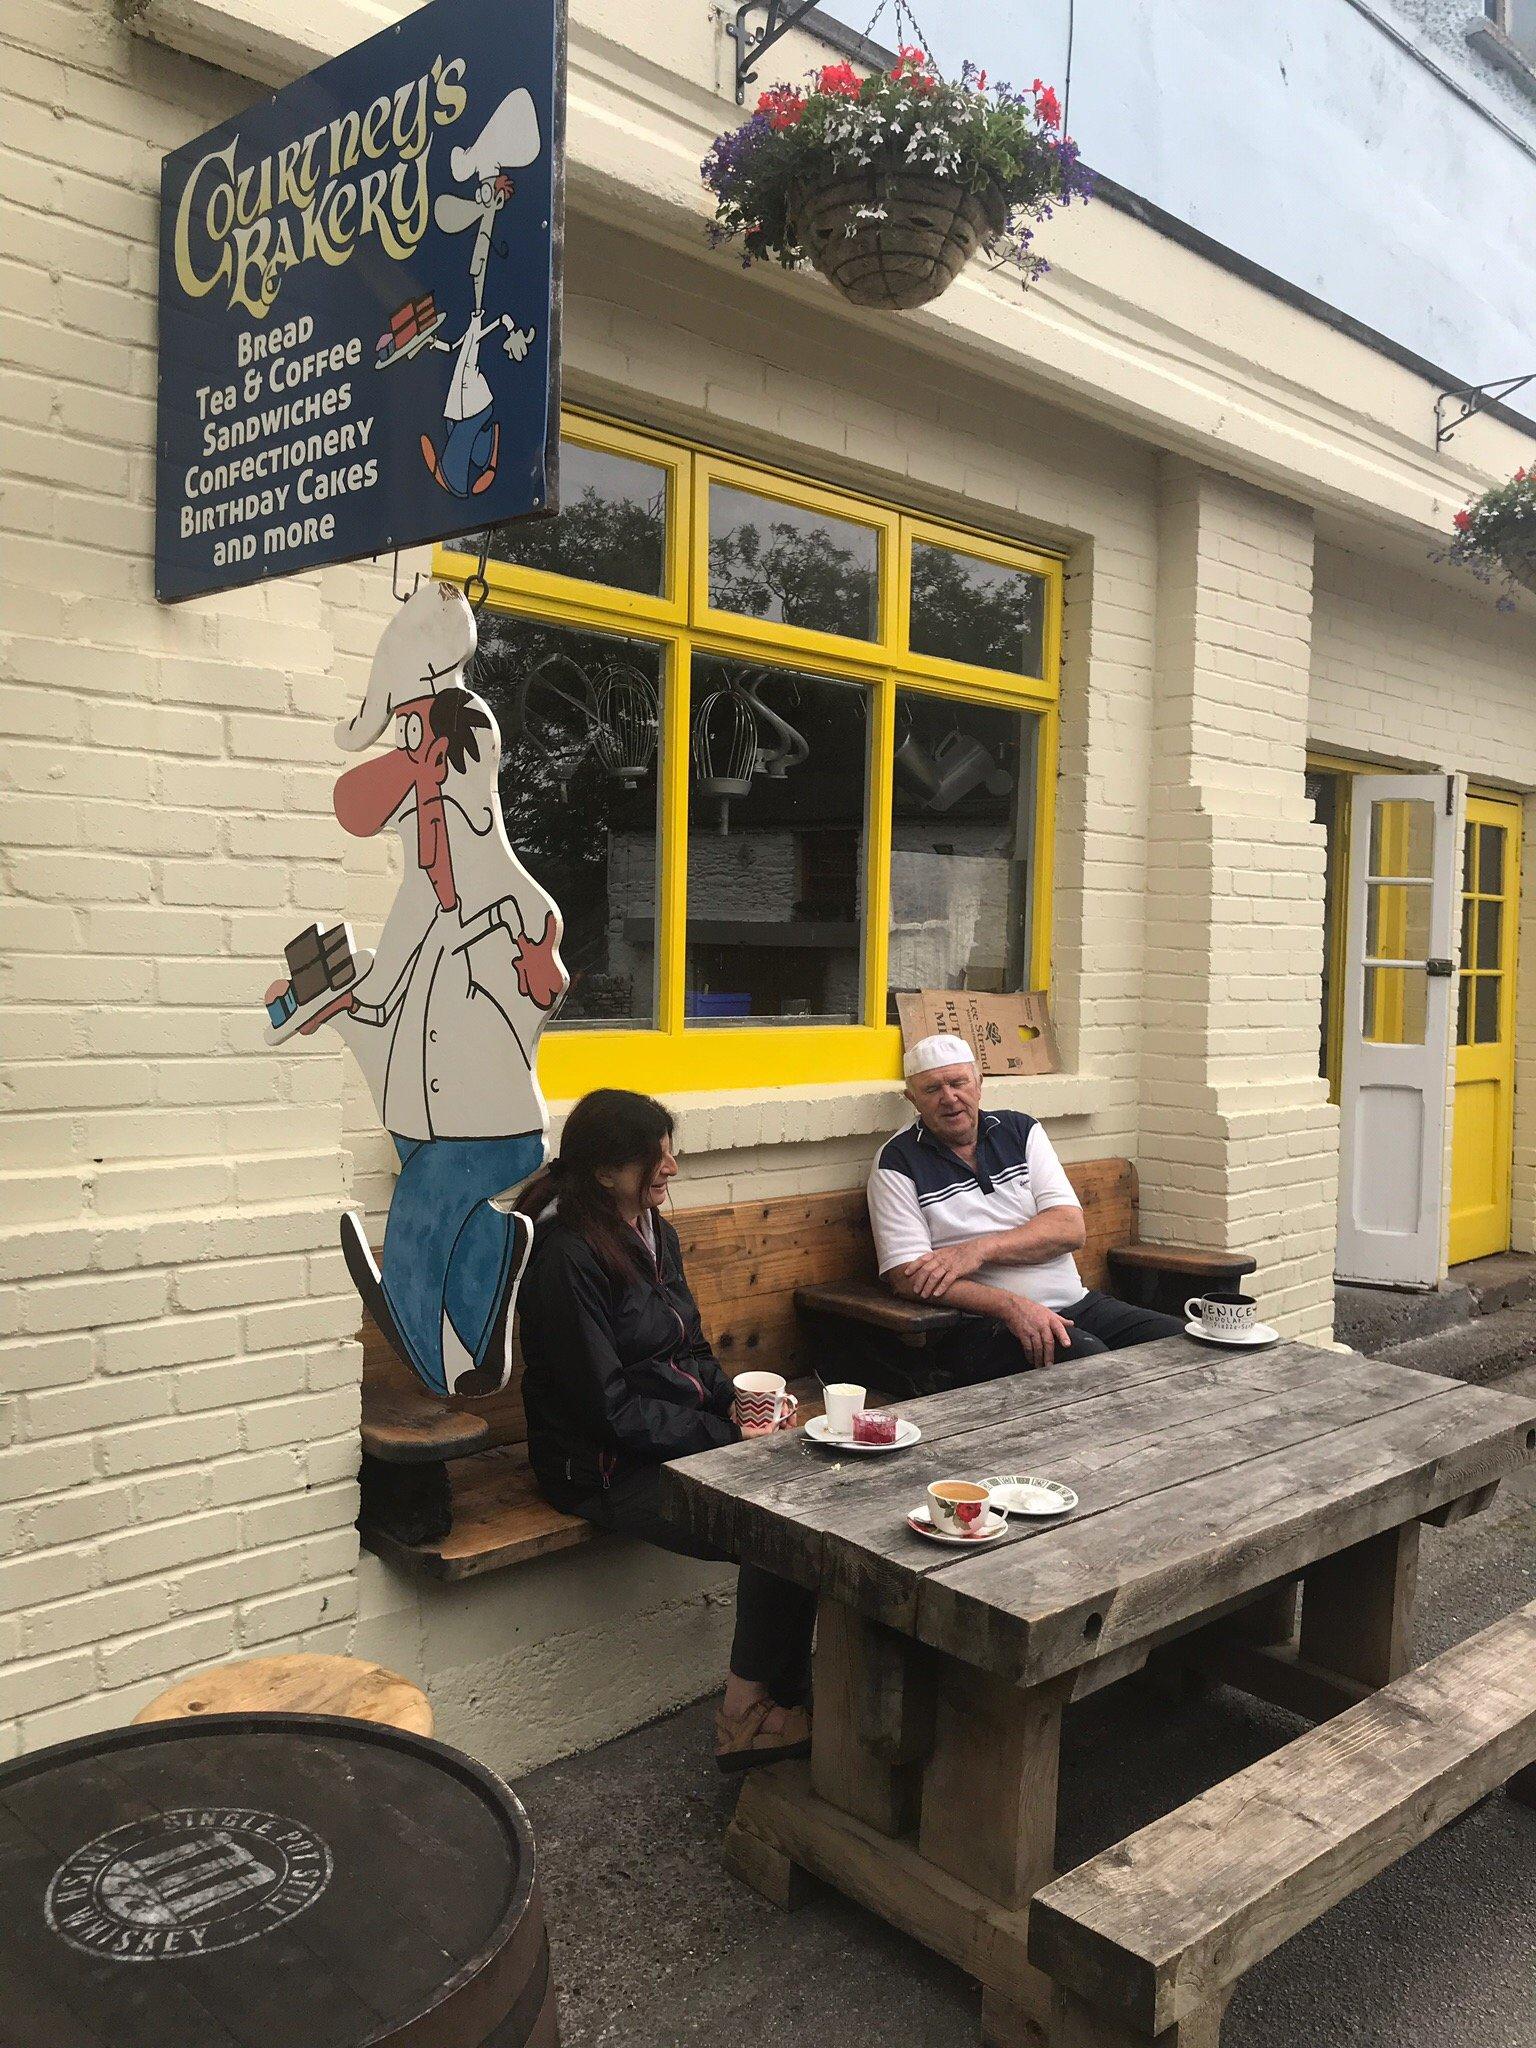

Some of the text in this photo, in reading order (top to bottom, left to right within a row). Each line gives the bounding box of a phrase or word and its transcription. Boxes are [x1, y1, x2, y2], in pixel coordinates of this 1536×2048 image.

[237, 315, 314, 367] Bread
[196, 337, 362, 420] Tea & Coffee
[203, 382, 352, 456] Sandwiches
[184, 416, 374, 499] Confectionery
[180, 458, 378, 538] Birthday Cakes
[213, 513, 335, 567] and more
[935, 1012, 948, 1034] MI
[946, 1001, 962, 1039] BUT
[969, 999, 978, 1021] Lee
[975, 1025, 991, 1070] Strand
[163, 1813, 277, 1834] SINGLE
[276, 1830, 320, 1860] POT
[56, 1843, 208, 1953] IRISH WHISKEY
